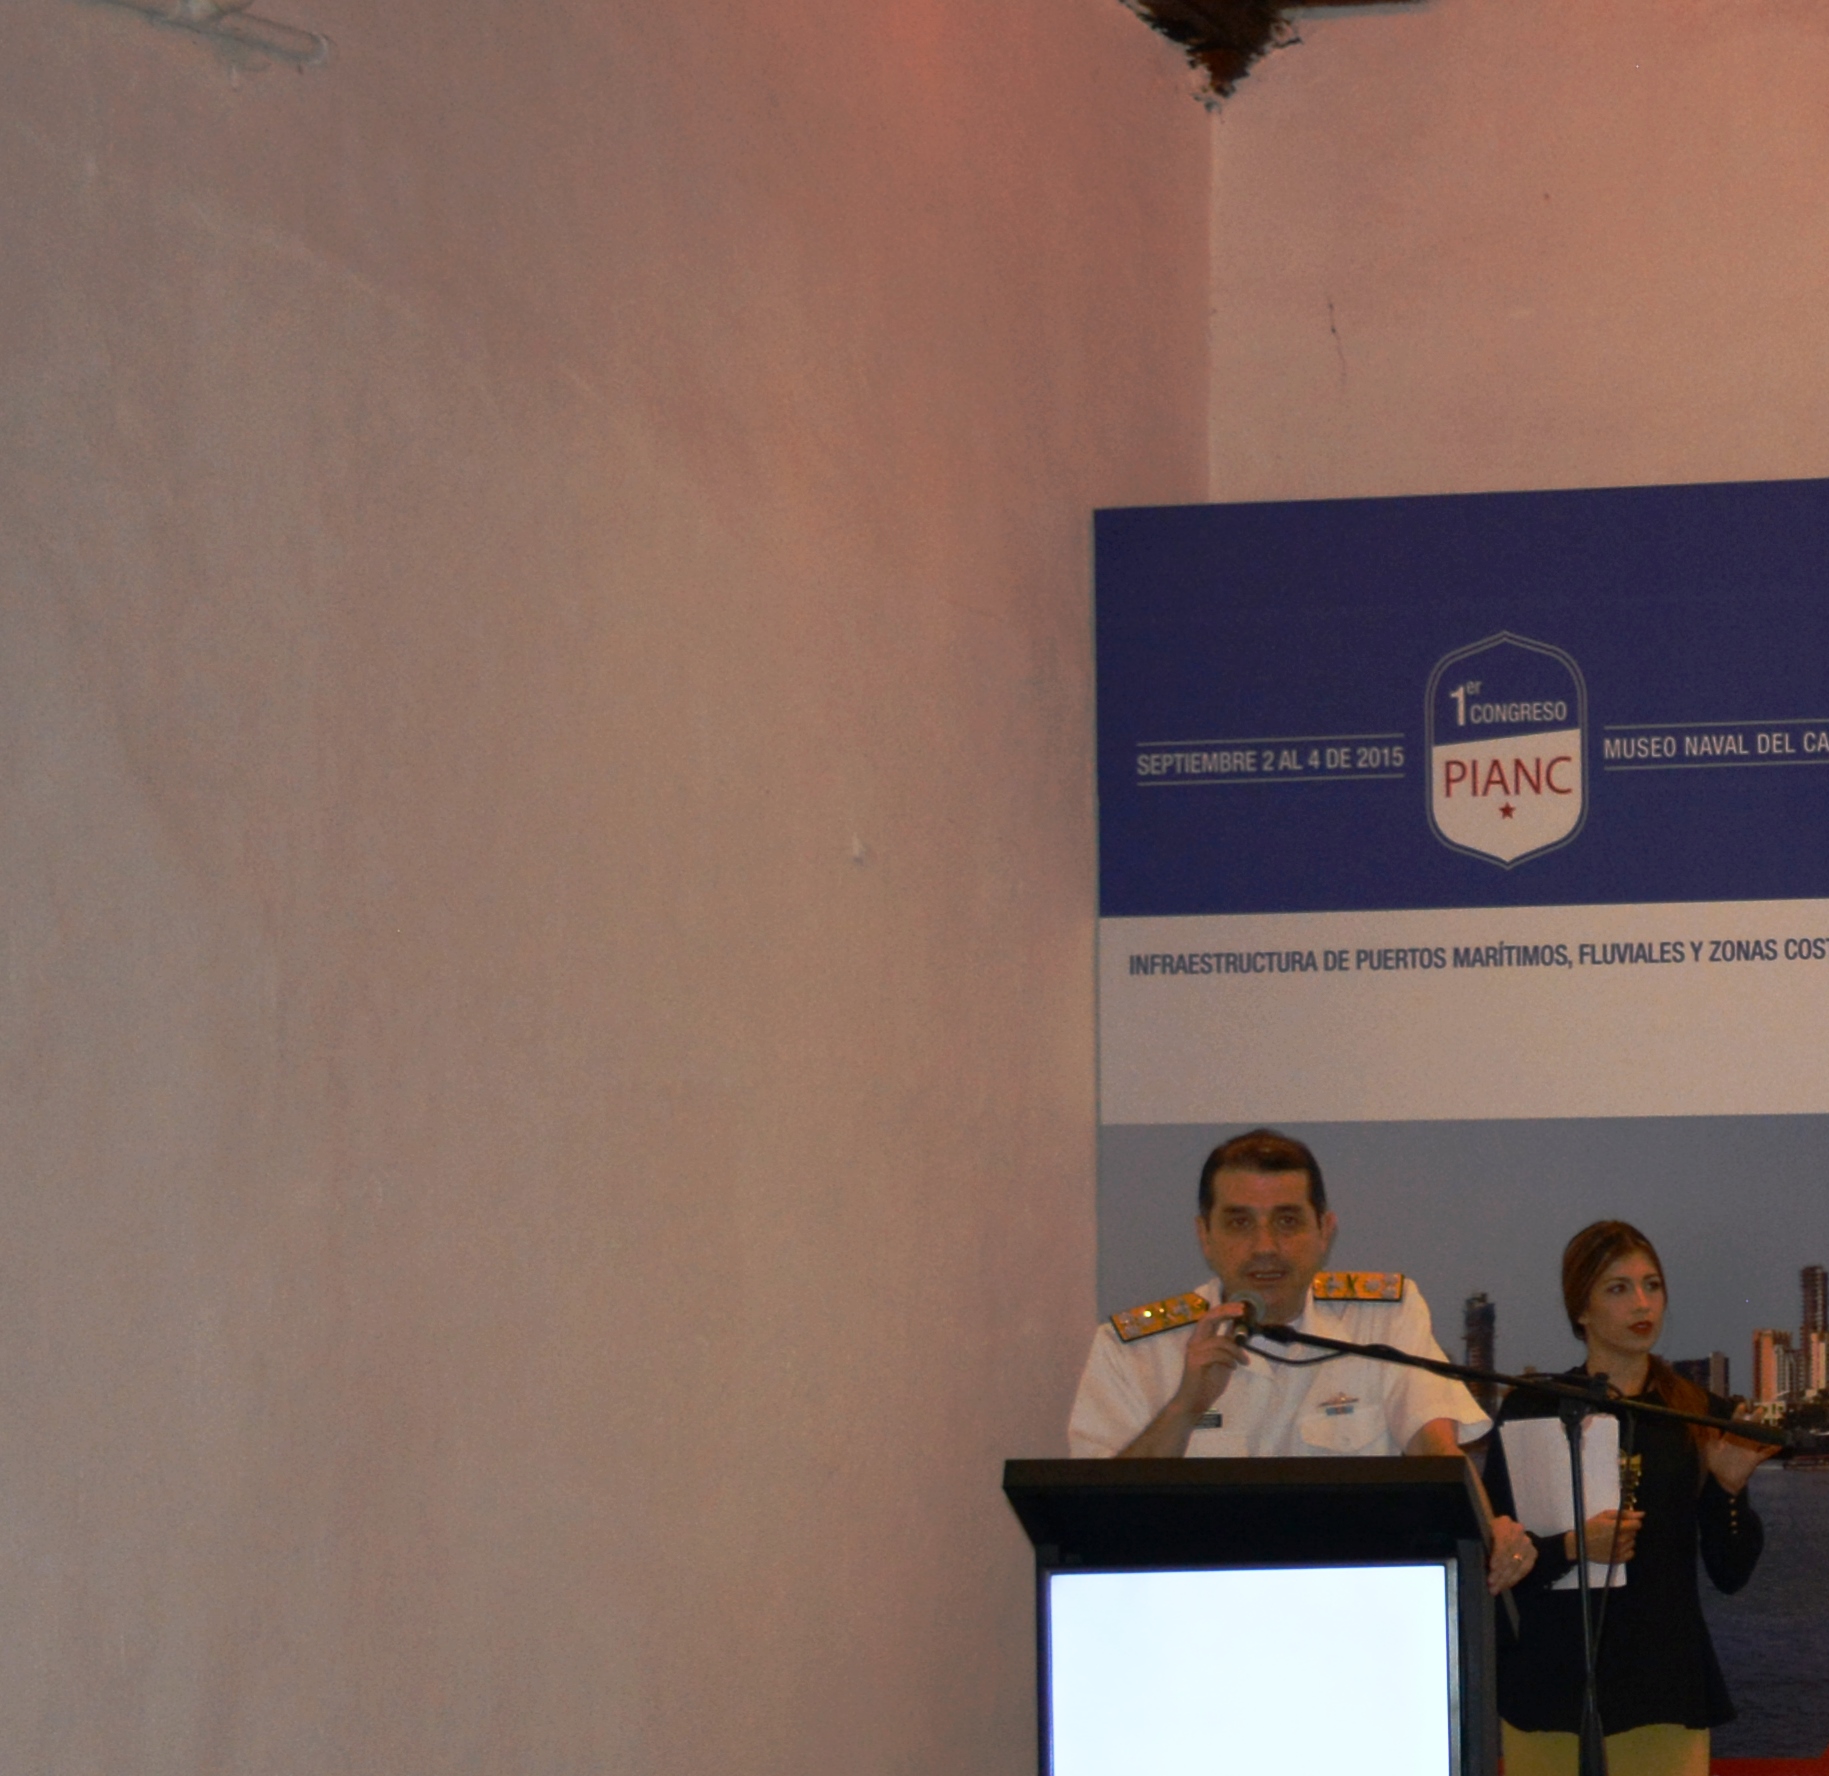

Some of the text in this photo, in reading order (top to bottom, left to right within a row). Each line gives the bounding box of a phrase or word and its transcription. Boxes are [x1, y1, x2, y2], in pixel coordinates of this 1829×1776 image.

[1469, 700, 1568, 724] CONGRESO
[1136, 745, 1405, 776] SEPTIEMBRE 2 AL 4 DE 2015
[1603, 735, 1677, 759] MUSEO
[1684, 734, 1750, 757] NAVAL
[1756, 732, 1796, 755] DEL
[1444, 755, 1573, 798] PIANC
[1127, 949, 1320, 977] INFRAESTRUCTURA
[1322, 948, 1351, 973] DE
[1355, 946, 1447, 972] PUERTOS
[1452, 940, 1573, 969] MARÍTIMOS,
[1578, 940, 1686, 965] FLUVIALES
[1689, 941, 1703, 962] Y
[1708, 938, 1778, 963] ZONAS
